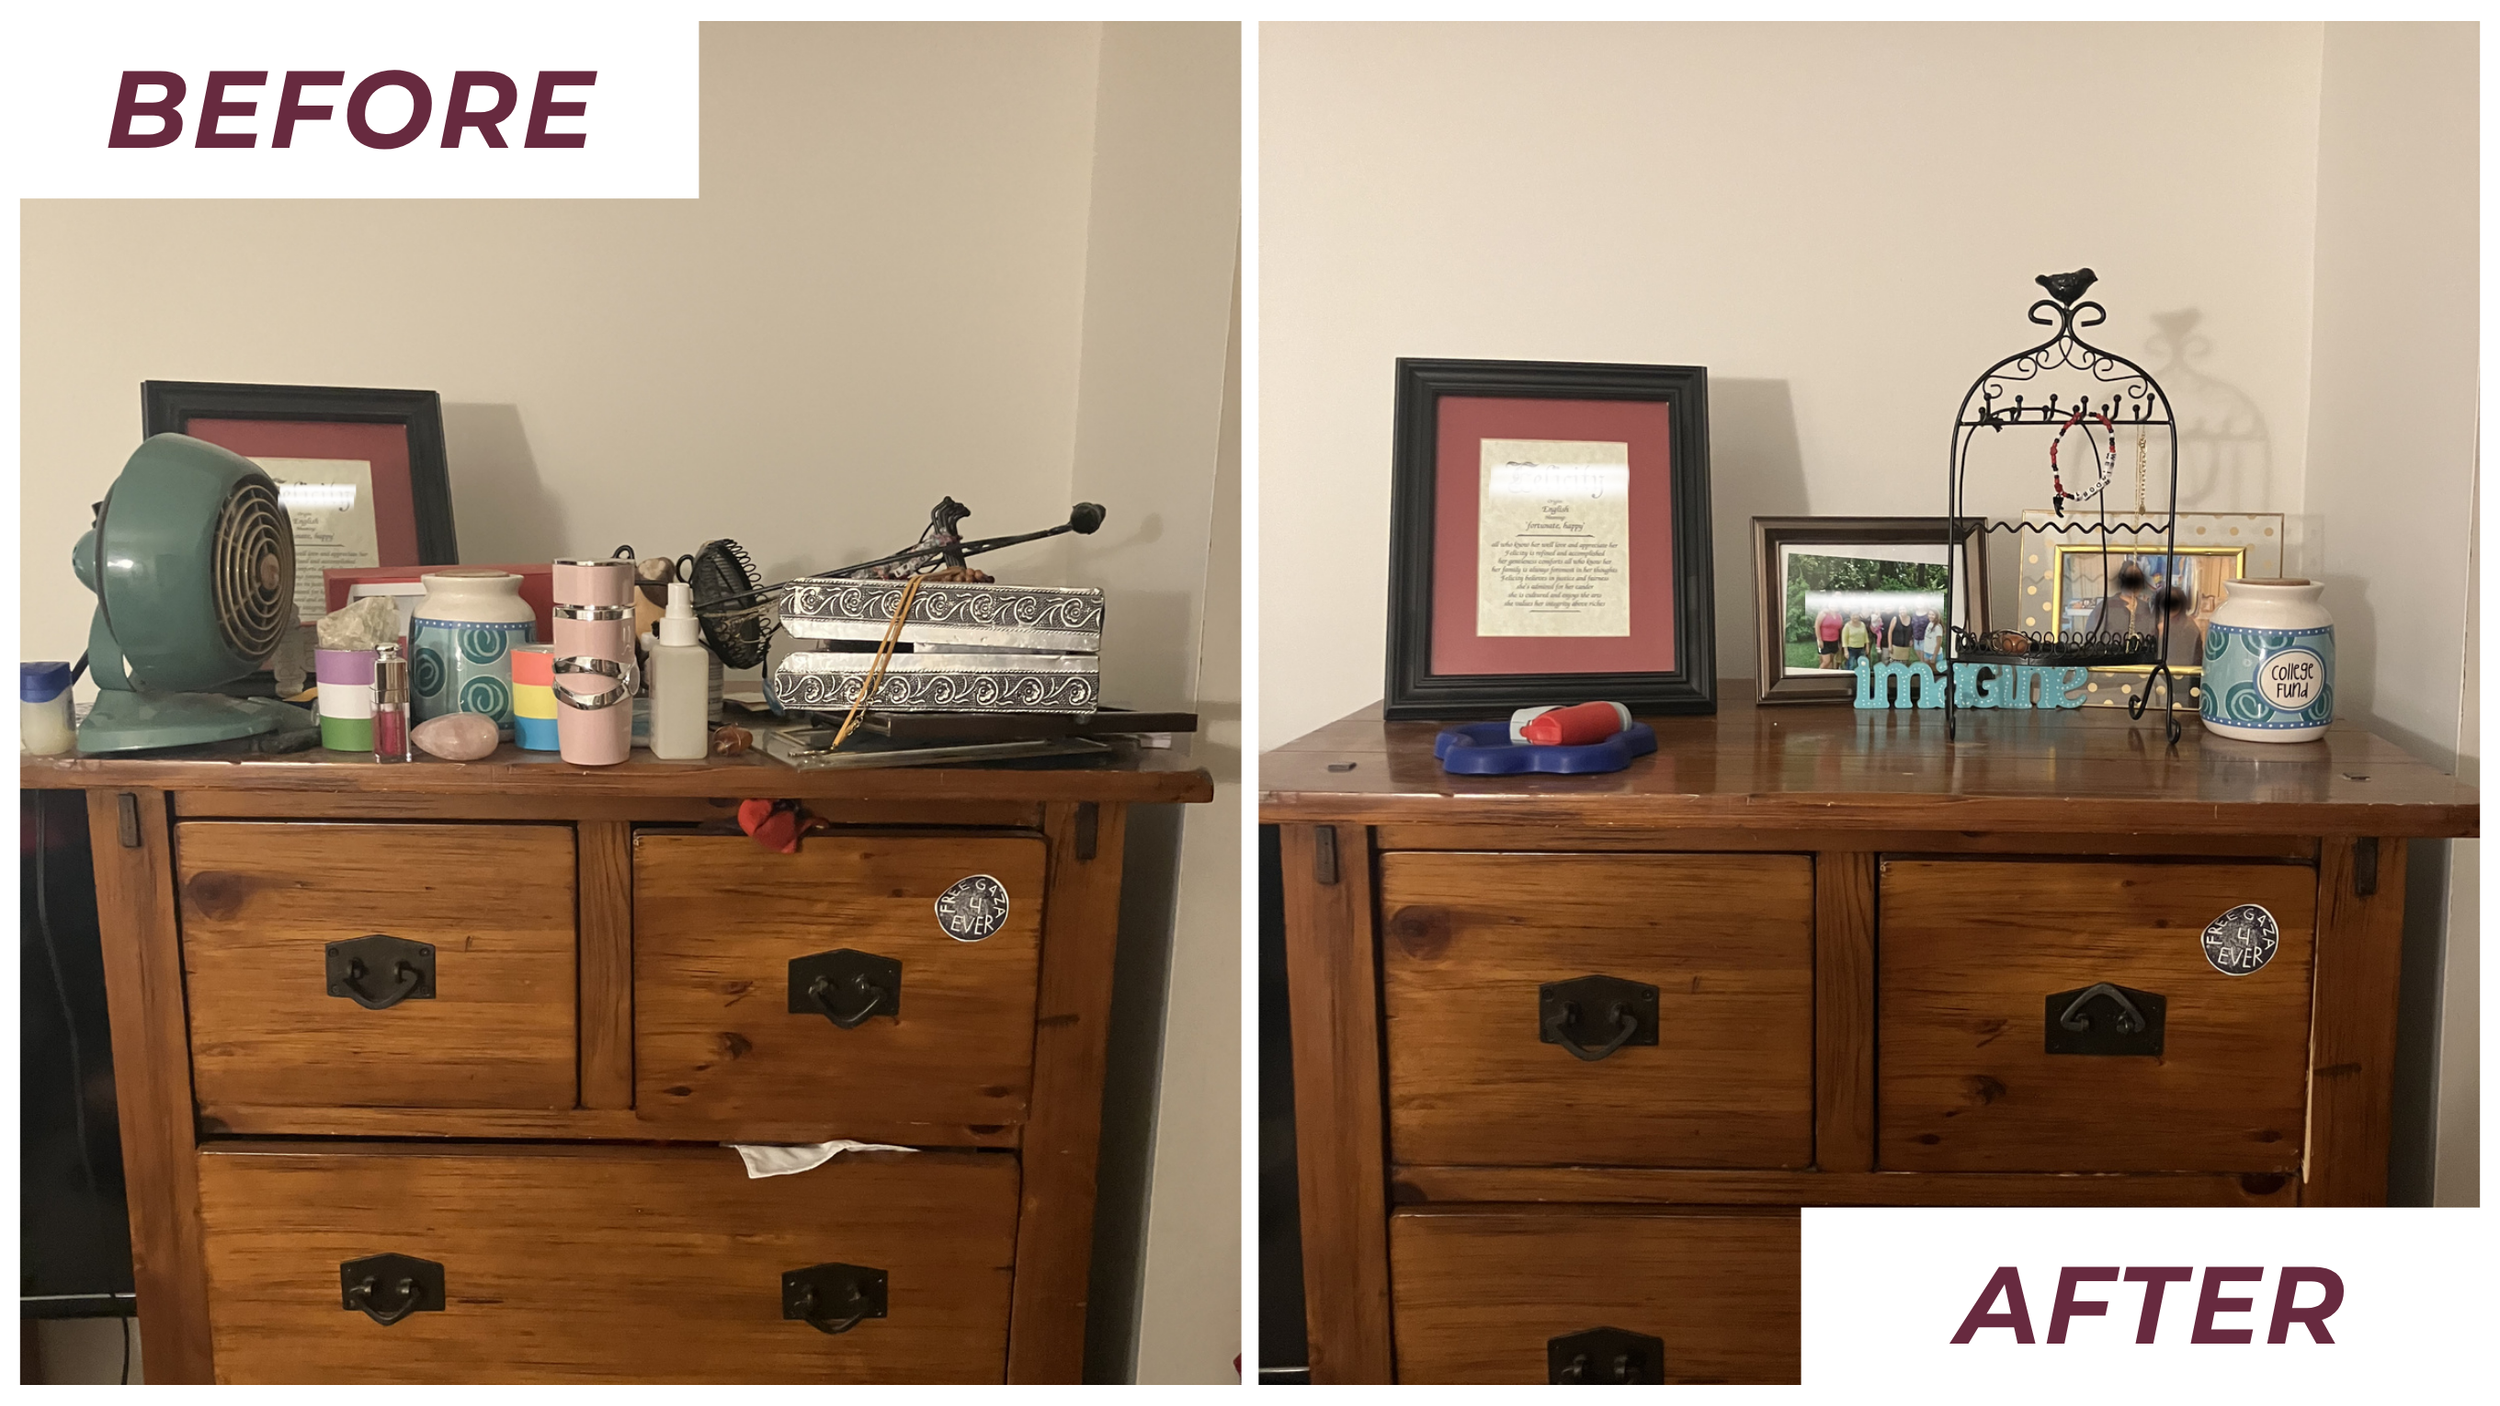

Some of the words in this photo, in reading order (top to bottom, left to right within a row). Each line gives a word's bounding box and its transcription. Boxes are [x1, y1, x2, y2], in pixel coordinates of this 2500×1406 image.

[1542, 505, 1569, 514] English
[940, 880, 970, 914] FREE
[975, 878, 1006, 918] GAZA
[969, 897, 982, 914] 4
[950, 914, 994, 935] EVER
[2206, 911, 2238, 945] FREE
[2243, 907, 2275, 950] GAZA
[2237, 927, 2250, 945] 4
[2217, 946, 2263, 968] EVER
